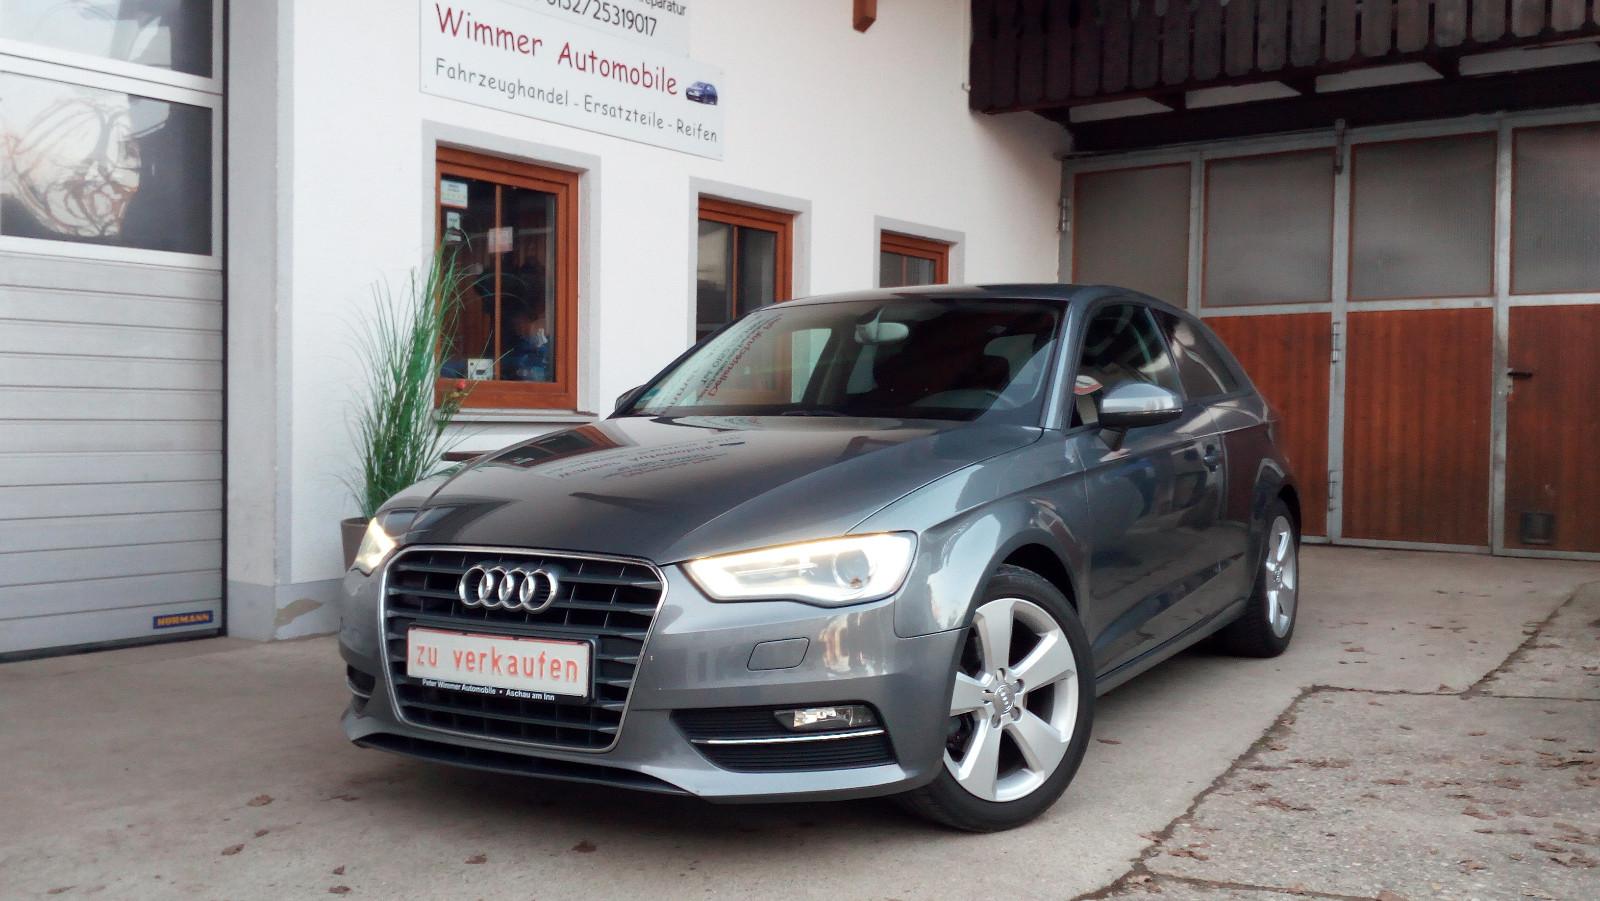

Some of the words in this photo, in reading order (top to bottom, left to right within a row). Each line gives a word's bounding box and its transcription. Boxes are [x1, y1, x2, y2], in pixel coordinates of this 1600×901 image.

[435, 3, 543, 56] Wimmer
[557, 42, 678, 95] Automobile
[435, 57, 569, 106] Fahrzeughandel
[584, 95, 664, 129] Ersatzteile
[676, 118, 717, 143] Reifen
[416, 645, 438, 667] zu
[453, 646, 578, 683] verkaufen
[462, 684, 496, 695] Automobile
[506, 689, 530, 698] Aschau
[532, 692, 542, 700] am
[544, 693, 555, 701] Inn
